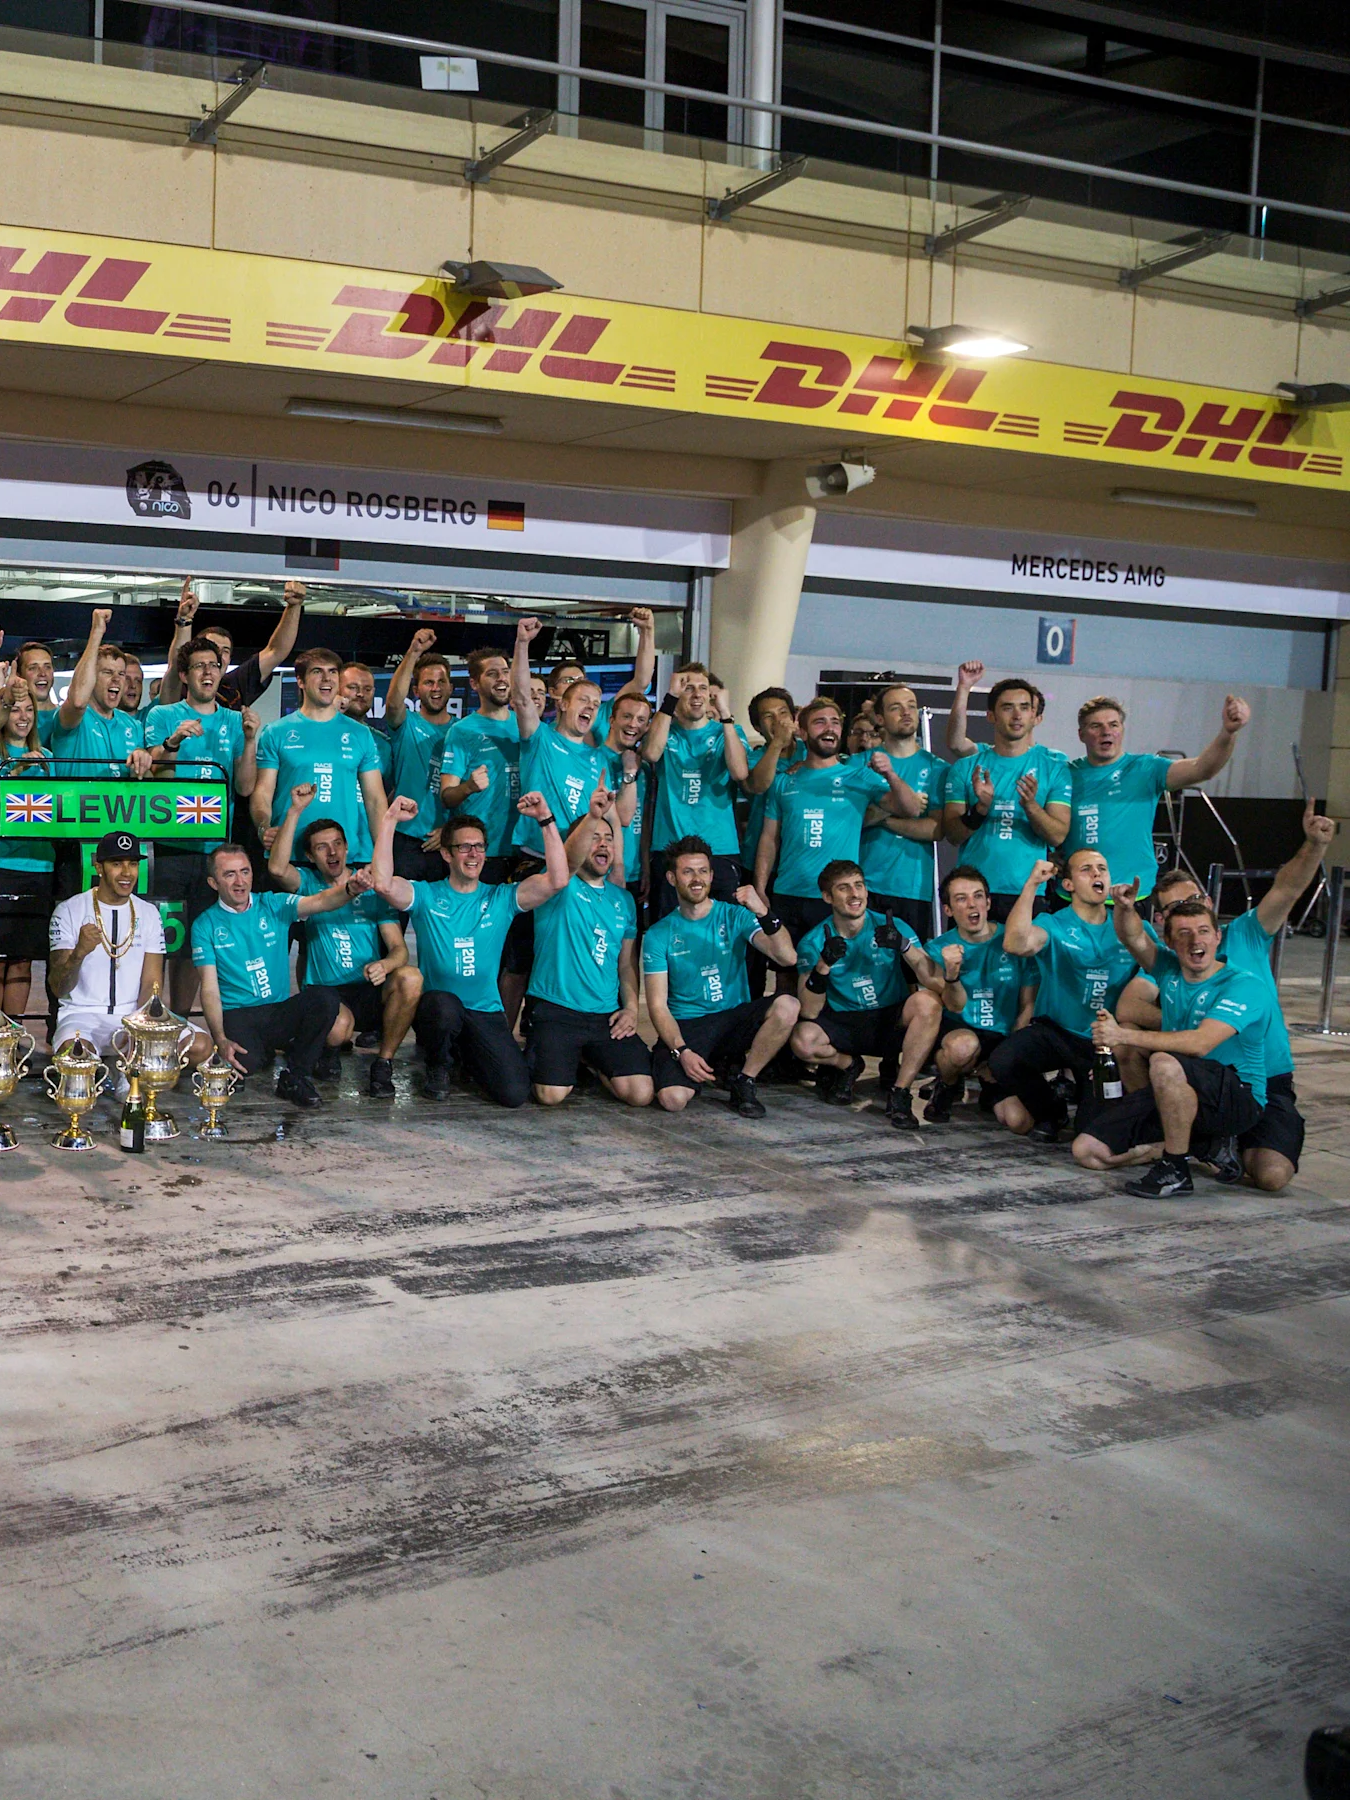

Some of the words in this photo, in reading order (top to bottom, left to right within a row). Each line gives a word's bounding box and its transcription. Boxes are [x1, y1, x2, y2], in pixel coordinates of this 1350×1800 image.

[325, 285, 625, 385] DHL
[754, 341, 998, 431] DHL
[1104, 391, 1307, 470] DHL
[207, 480, 240, 508] 06
[268, 485, 336, 515] NICO
[346, 491, 477, 526] ROSBERG
[1011, 553, 1119, 585] MERCEDES
[1124, 562, 1166, 588] AMG
[1046, 625, 1064, 657] 0
[319, 774, 333, 803] 2015
[430, 767, 441, 795] 2015
[688, 779, 701, 805] 2015
[57, 795, 172, 825] LEWIS
[809, 820, 824, 848] 2015
[999, 811, 1014, 840] 2015
[1086, 816, 1099, 844] 2015
[339, 940, 353, 969] 2015
[462, 949, 475, 977] 2015
[255, 968, 272, 999] 2015
[708, 975, 723, 1002] 2015
[1090, 981, 1108, 1010] 2015
[981, 1000, 994, 1027] 2015
